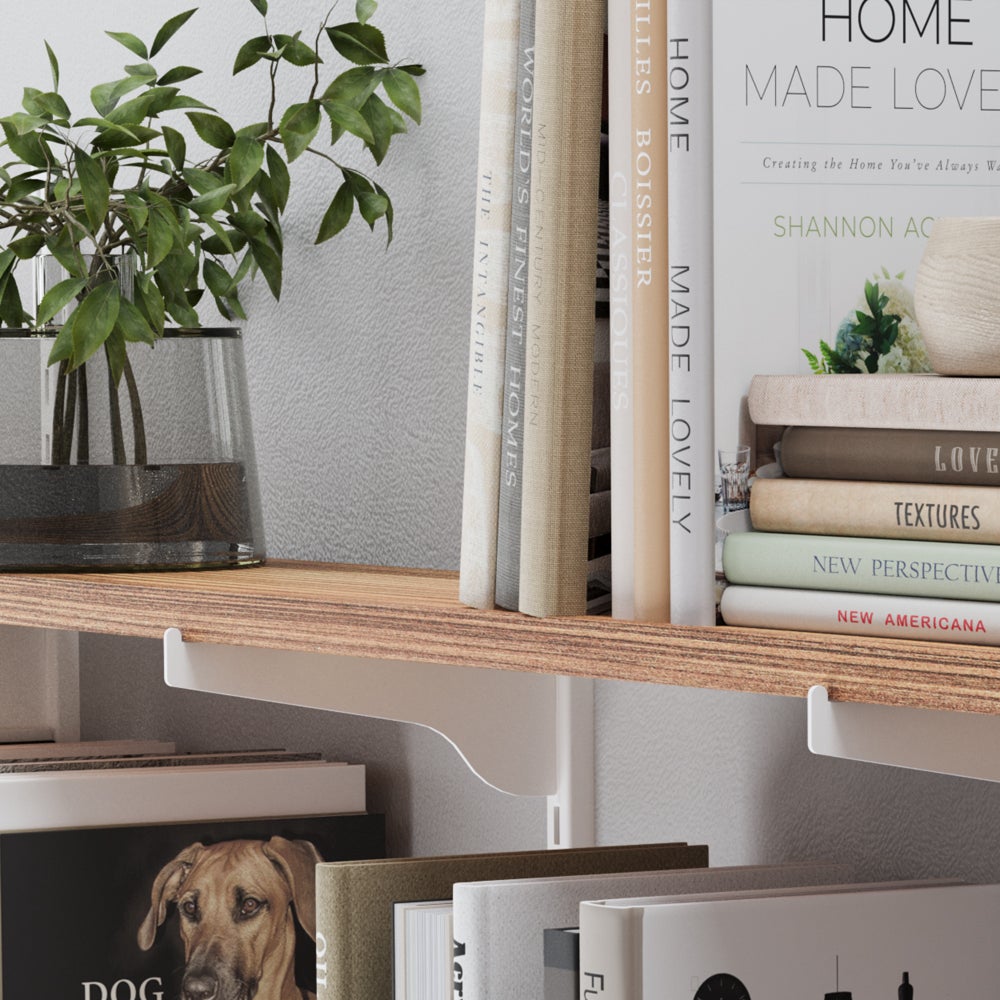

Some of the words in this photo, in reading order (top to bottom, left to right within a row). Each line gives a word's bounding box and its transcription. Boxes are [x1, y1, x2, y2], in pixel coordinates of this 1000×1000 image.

[822, 0, 973, 45] HOME
[669, 38, 690, 153] HOME
[745, 63, 873, 109] MADE
[517, 46, 535, 205] WORLD'S
[480, 170, 493, 221] THE
[762, 156, 818, 173] Creating
[823, 158, 844, 171] the
[849, 158, 883, 171] Home
[889, 158, 930, 171] You've
[935, 160, 980, 174] Always
[636, 128, 652, 288] BOISSIER
[773, 215, 894, 238] SHANNON
[472, 240, 489, 396] INTANGIBLE
[511, 226, 528, 345] FINEST
[670, 265, 691, 373] MADE
[528, 324, 542, 426] MODERN
[505, 366, 521, 488] HOMES
[933, 445, 1000, 474] LOVE
[670, 399, 693, 535] LOVELY
[893, 501, 981, 531] TEXTURES
[811, 555, 862, 577] NEW
[836, 609, 875, 626] NEW
[884, 613, 987, 634] AMERICANA
